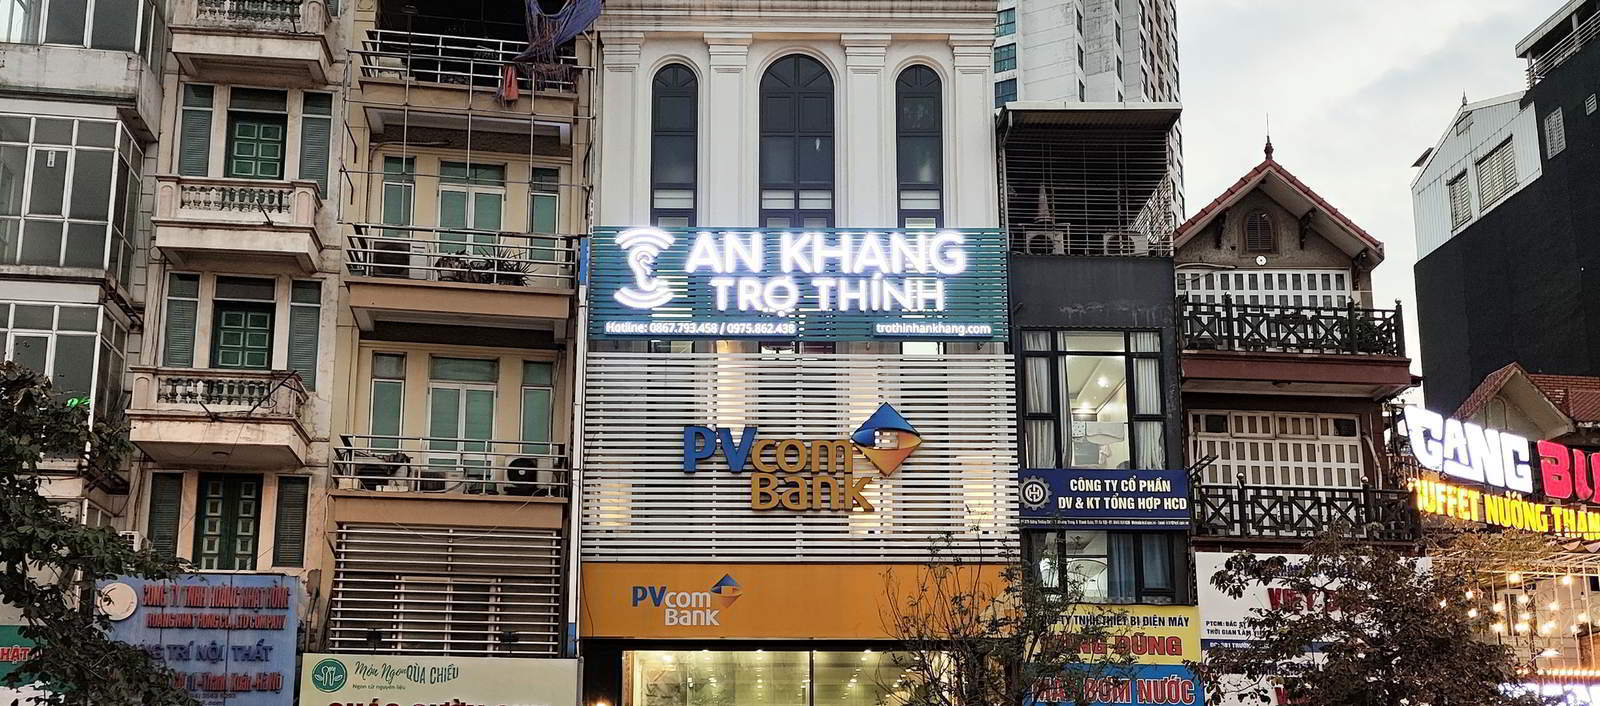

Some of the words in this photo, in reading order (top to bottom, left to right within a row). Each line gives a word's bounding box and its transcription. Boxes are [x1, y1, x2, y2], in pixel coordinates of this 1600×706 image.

[685, 231, 761, 274] AN
[780, 231, 967, 275] KHANG
[710, 275, 798, 317] TRỢ
[811, 272, 945, 312] THÍNH
[605, 321, 648, 333] Hotline:
[650, 322, 718, 334] 0867.793.458
[876, 322, 991, 336] trothinhankhang.com
[1404, 405, 1533, 494] GANG
[750, 472, 875, 512] Bank
[1070, 476, 1101, 492] CÔNG
[1104, 480, 1118, 492] TY
[1121, 475, 1137, 492] CỔ
[1139, 476, 1171, 492] PHẦN
[1075, 497, 1084, 509] &
[1086, 497, 1100, 509] KT
[1104, 493, 1135, 510] TỔNG
[1138, 497, 1161, 512] HỢP
[1164, 497, 1187, 510] HCD
[1416, 479, 1480, 522] UFFET
[1484, 491, 1549, 533] NƯỚNG
[632, 585, 711, 608] PVcom
[664, 608, 720, 627] Bank
[1131, 616, 1140, 628] BỊ
[1143, 614, 1165, 628] ĐIỆN
[1168, 615, 1189, 626] MÁY
[166, 641, 194, 661] TRÍ
[196, 641, 225, 663] NỘI
[231, 639, 273, 662] THẤT
[1137, 674, 1196, 704] NƯỚC
